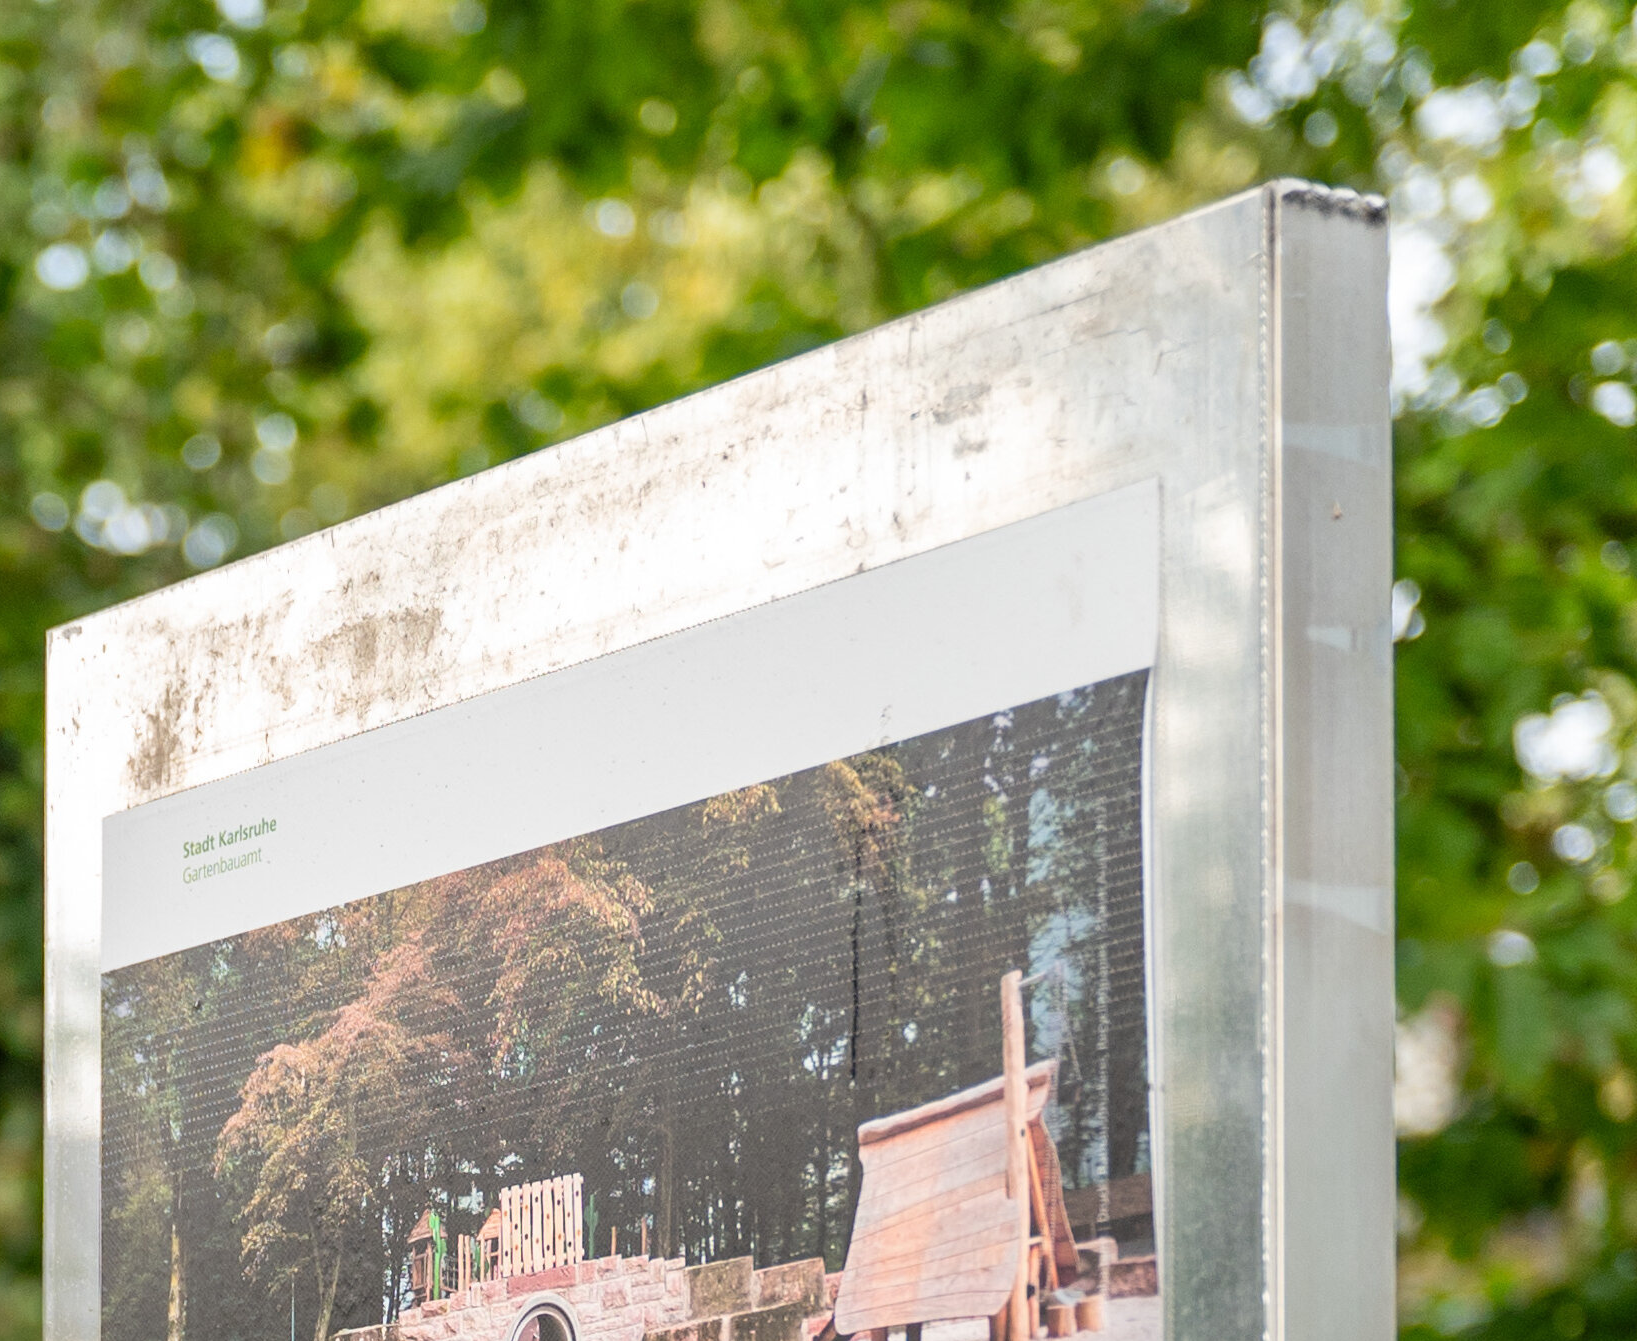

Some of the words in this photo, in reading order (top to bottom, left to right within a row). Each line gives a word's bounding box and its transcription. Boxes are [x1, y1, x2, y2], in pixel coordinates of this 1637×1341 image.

[182, 834, 216, 859] Stadt
[218, 817, 277, 848] Karlsruhe
[182, 847, 262, 884] Gartenbauamt
